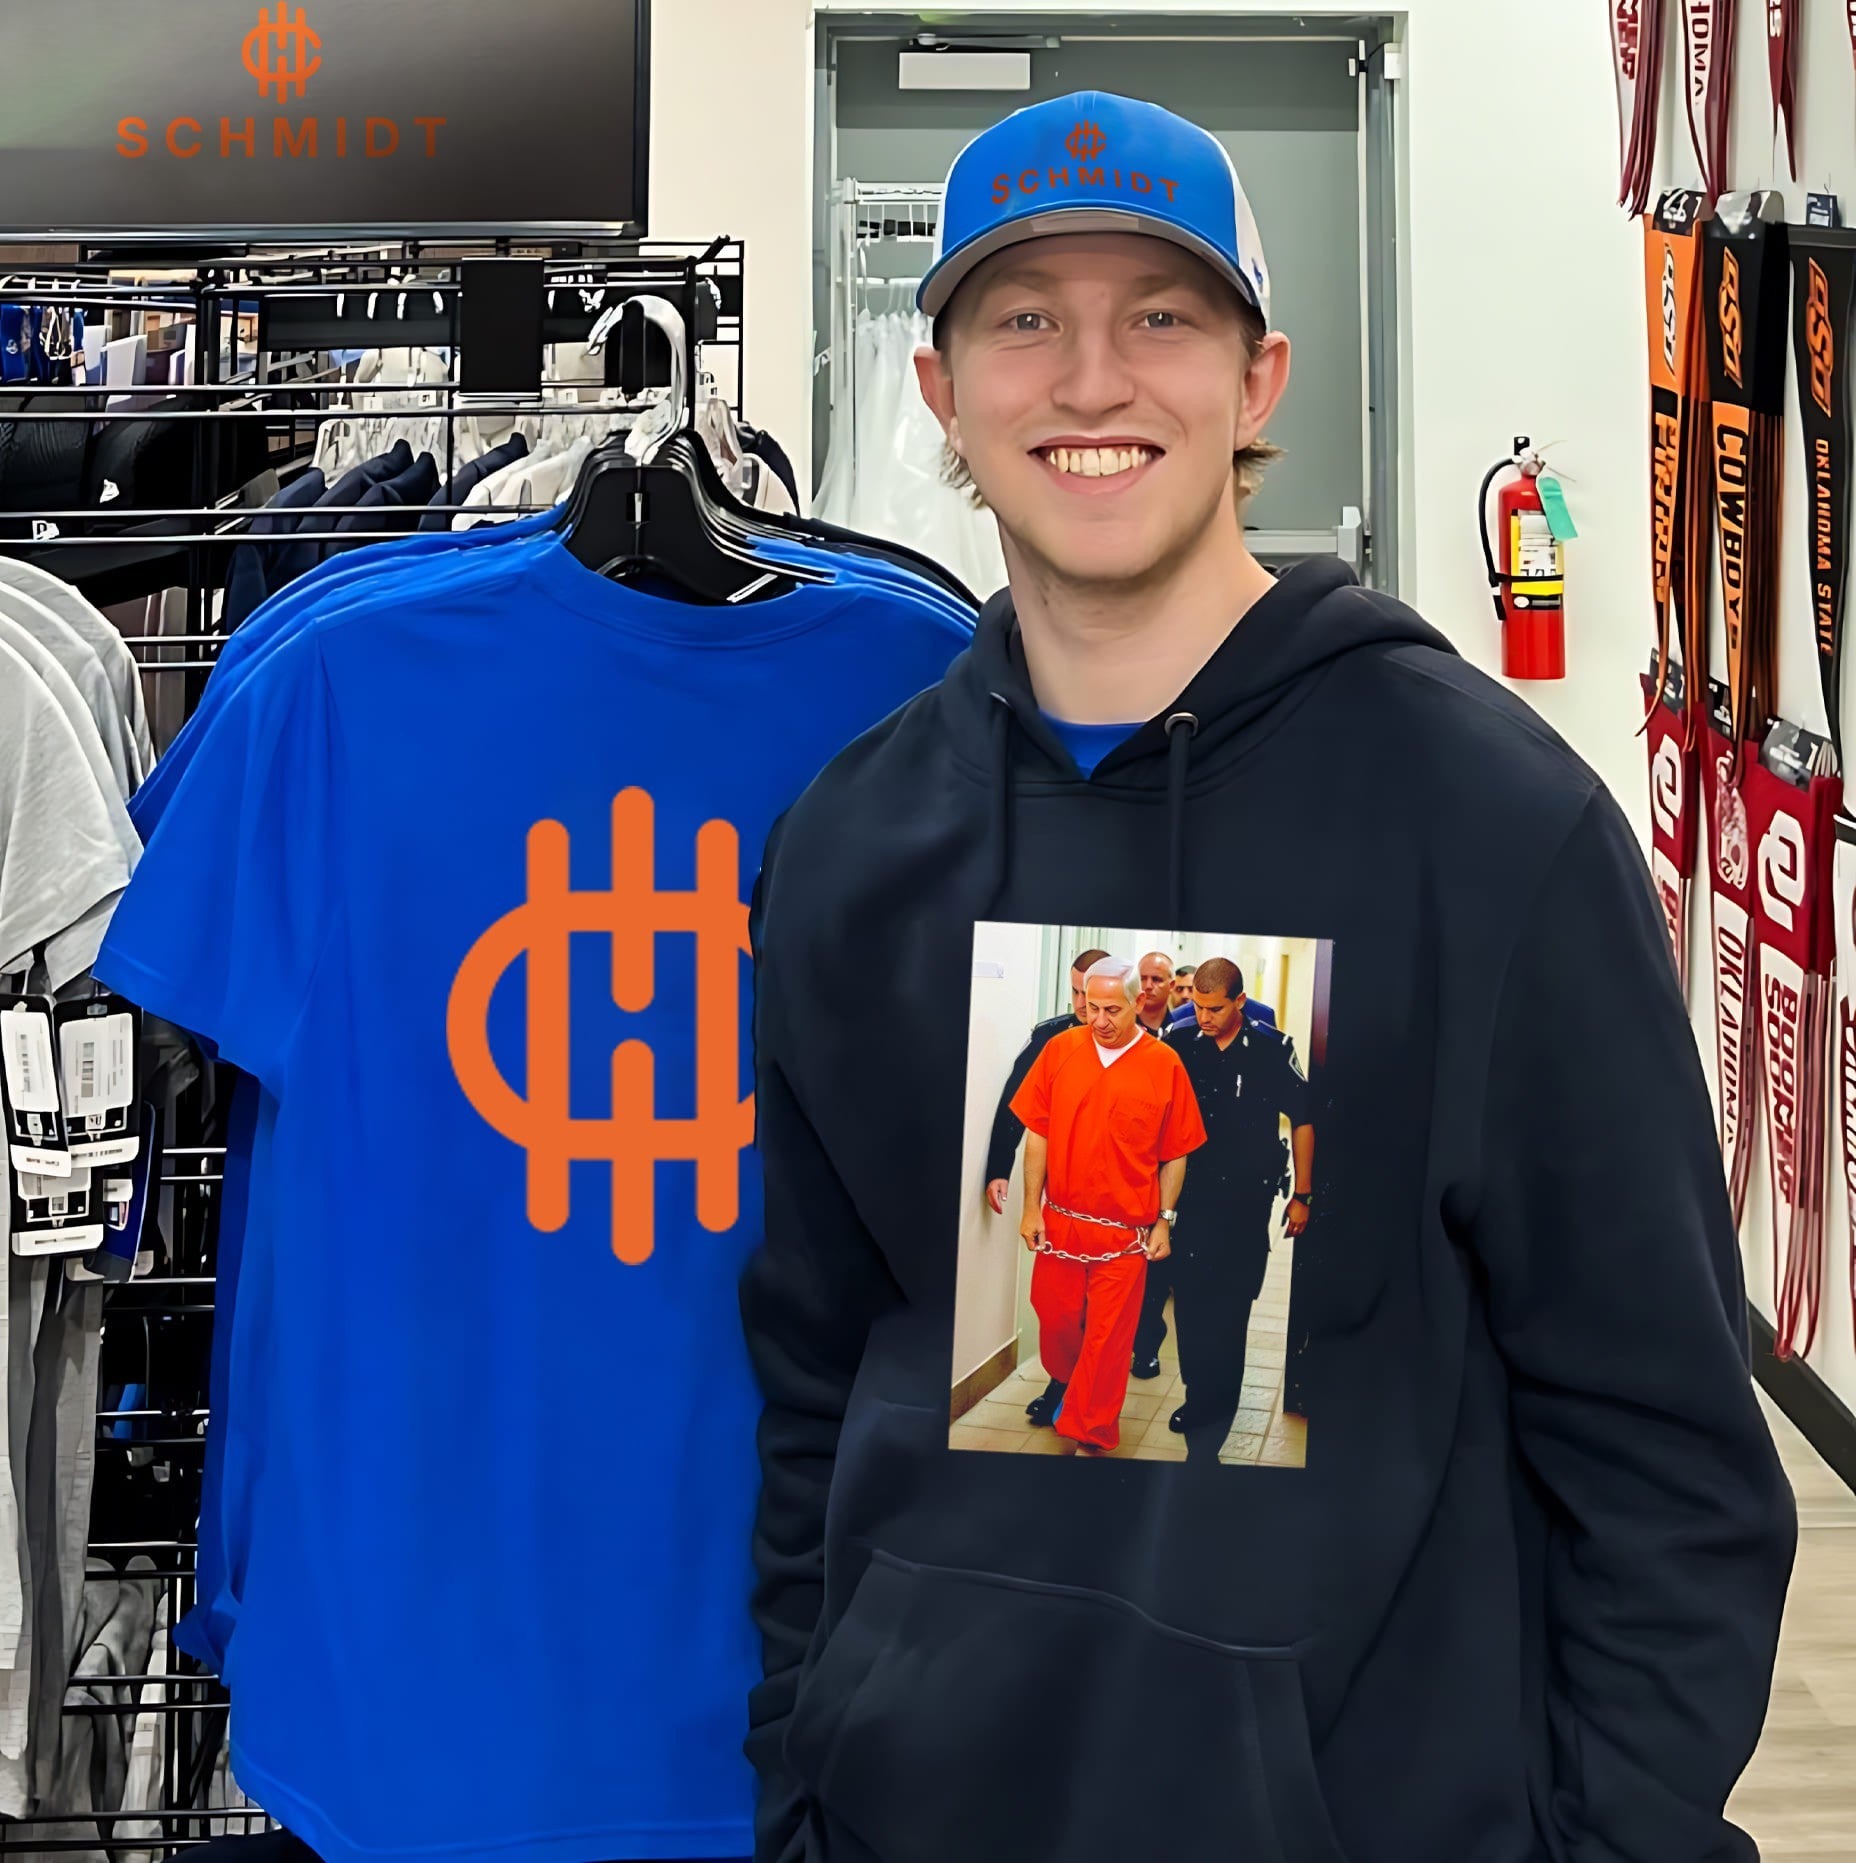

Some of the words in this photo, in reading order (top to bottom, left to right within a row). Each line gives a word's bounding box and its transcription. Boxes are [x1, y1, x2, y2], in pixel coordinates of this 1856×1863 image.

[116, 116, 447, 159] SCHMIDT
[991, 167, 1179, 205] SCHMIDT
[1815, 439, 1832, 571] OKLAHOMA
[1717, 925, 1745, 1144] OKLAHOMA
